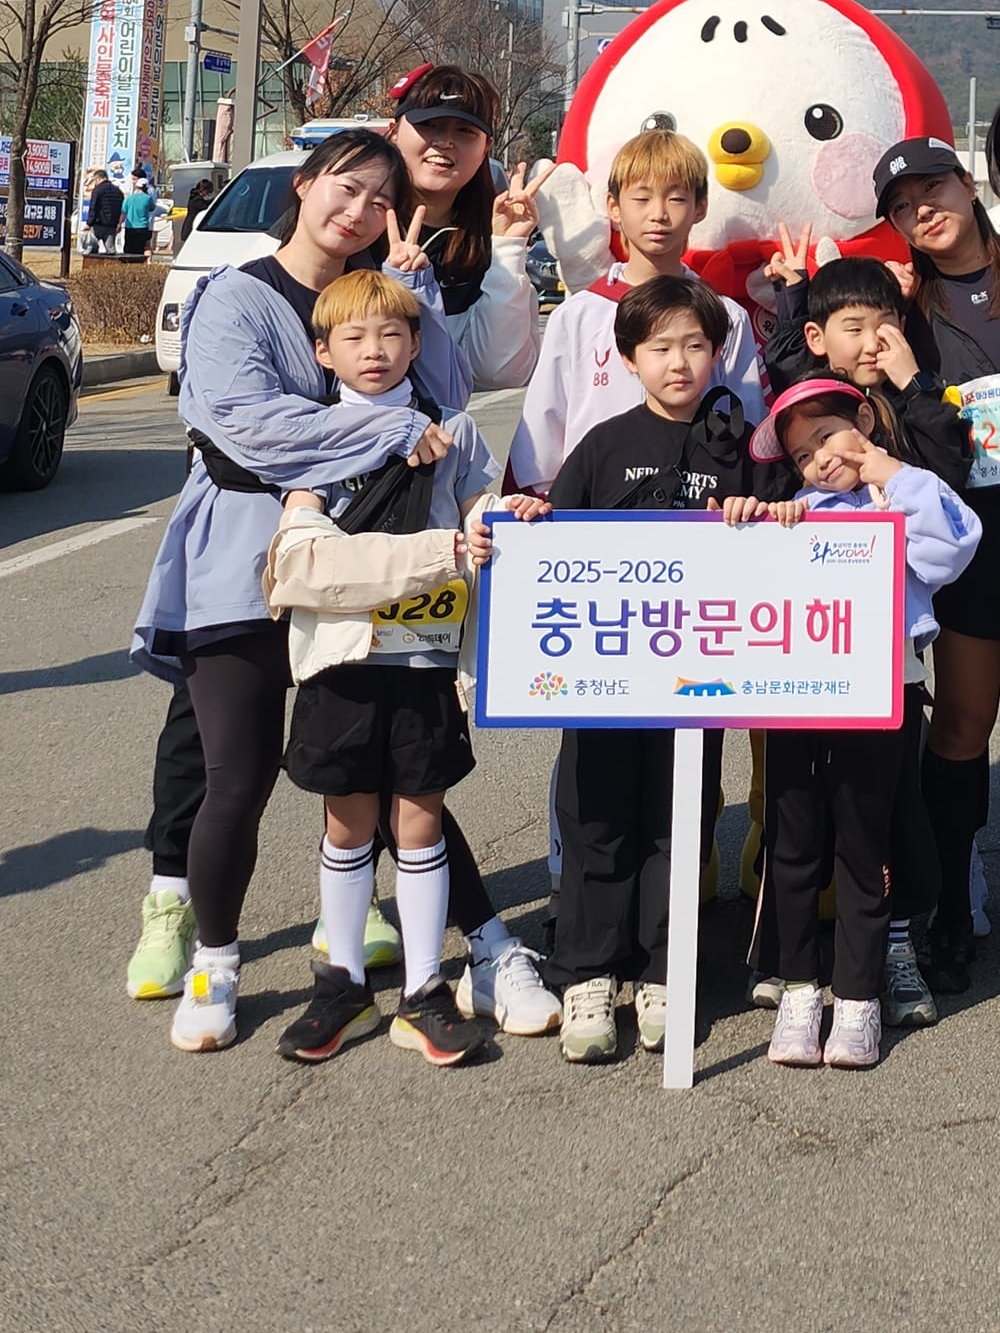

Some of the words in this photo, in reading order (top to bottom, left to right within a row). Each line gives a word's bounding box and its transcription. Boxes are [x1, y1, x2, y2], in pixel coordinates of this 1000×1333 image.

[117, 22, 137, 91] 어린이날
[112, 97, 132, 148] 큰잔치
[593, 372, 609, 386] 88
[537, 559, 684, 584] 2025-2026
[573, 678, 631, 696] 충청남도
[741, 679, 852, 697] 충남문화관광재단
